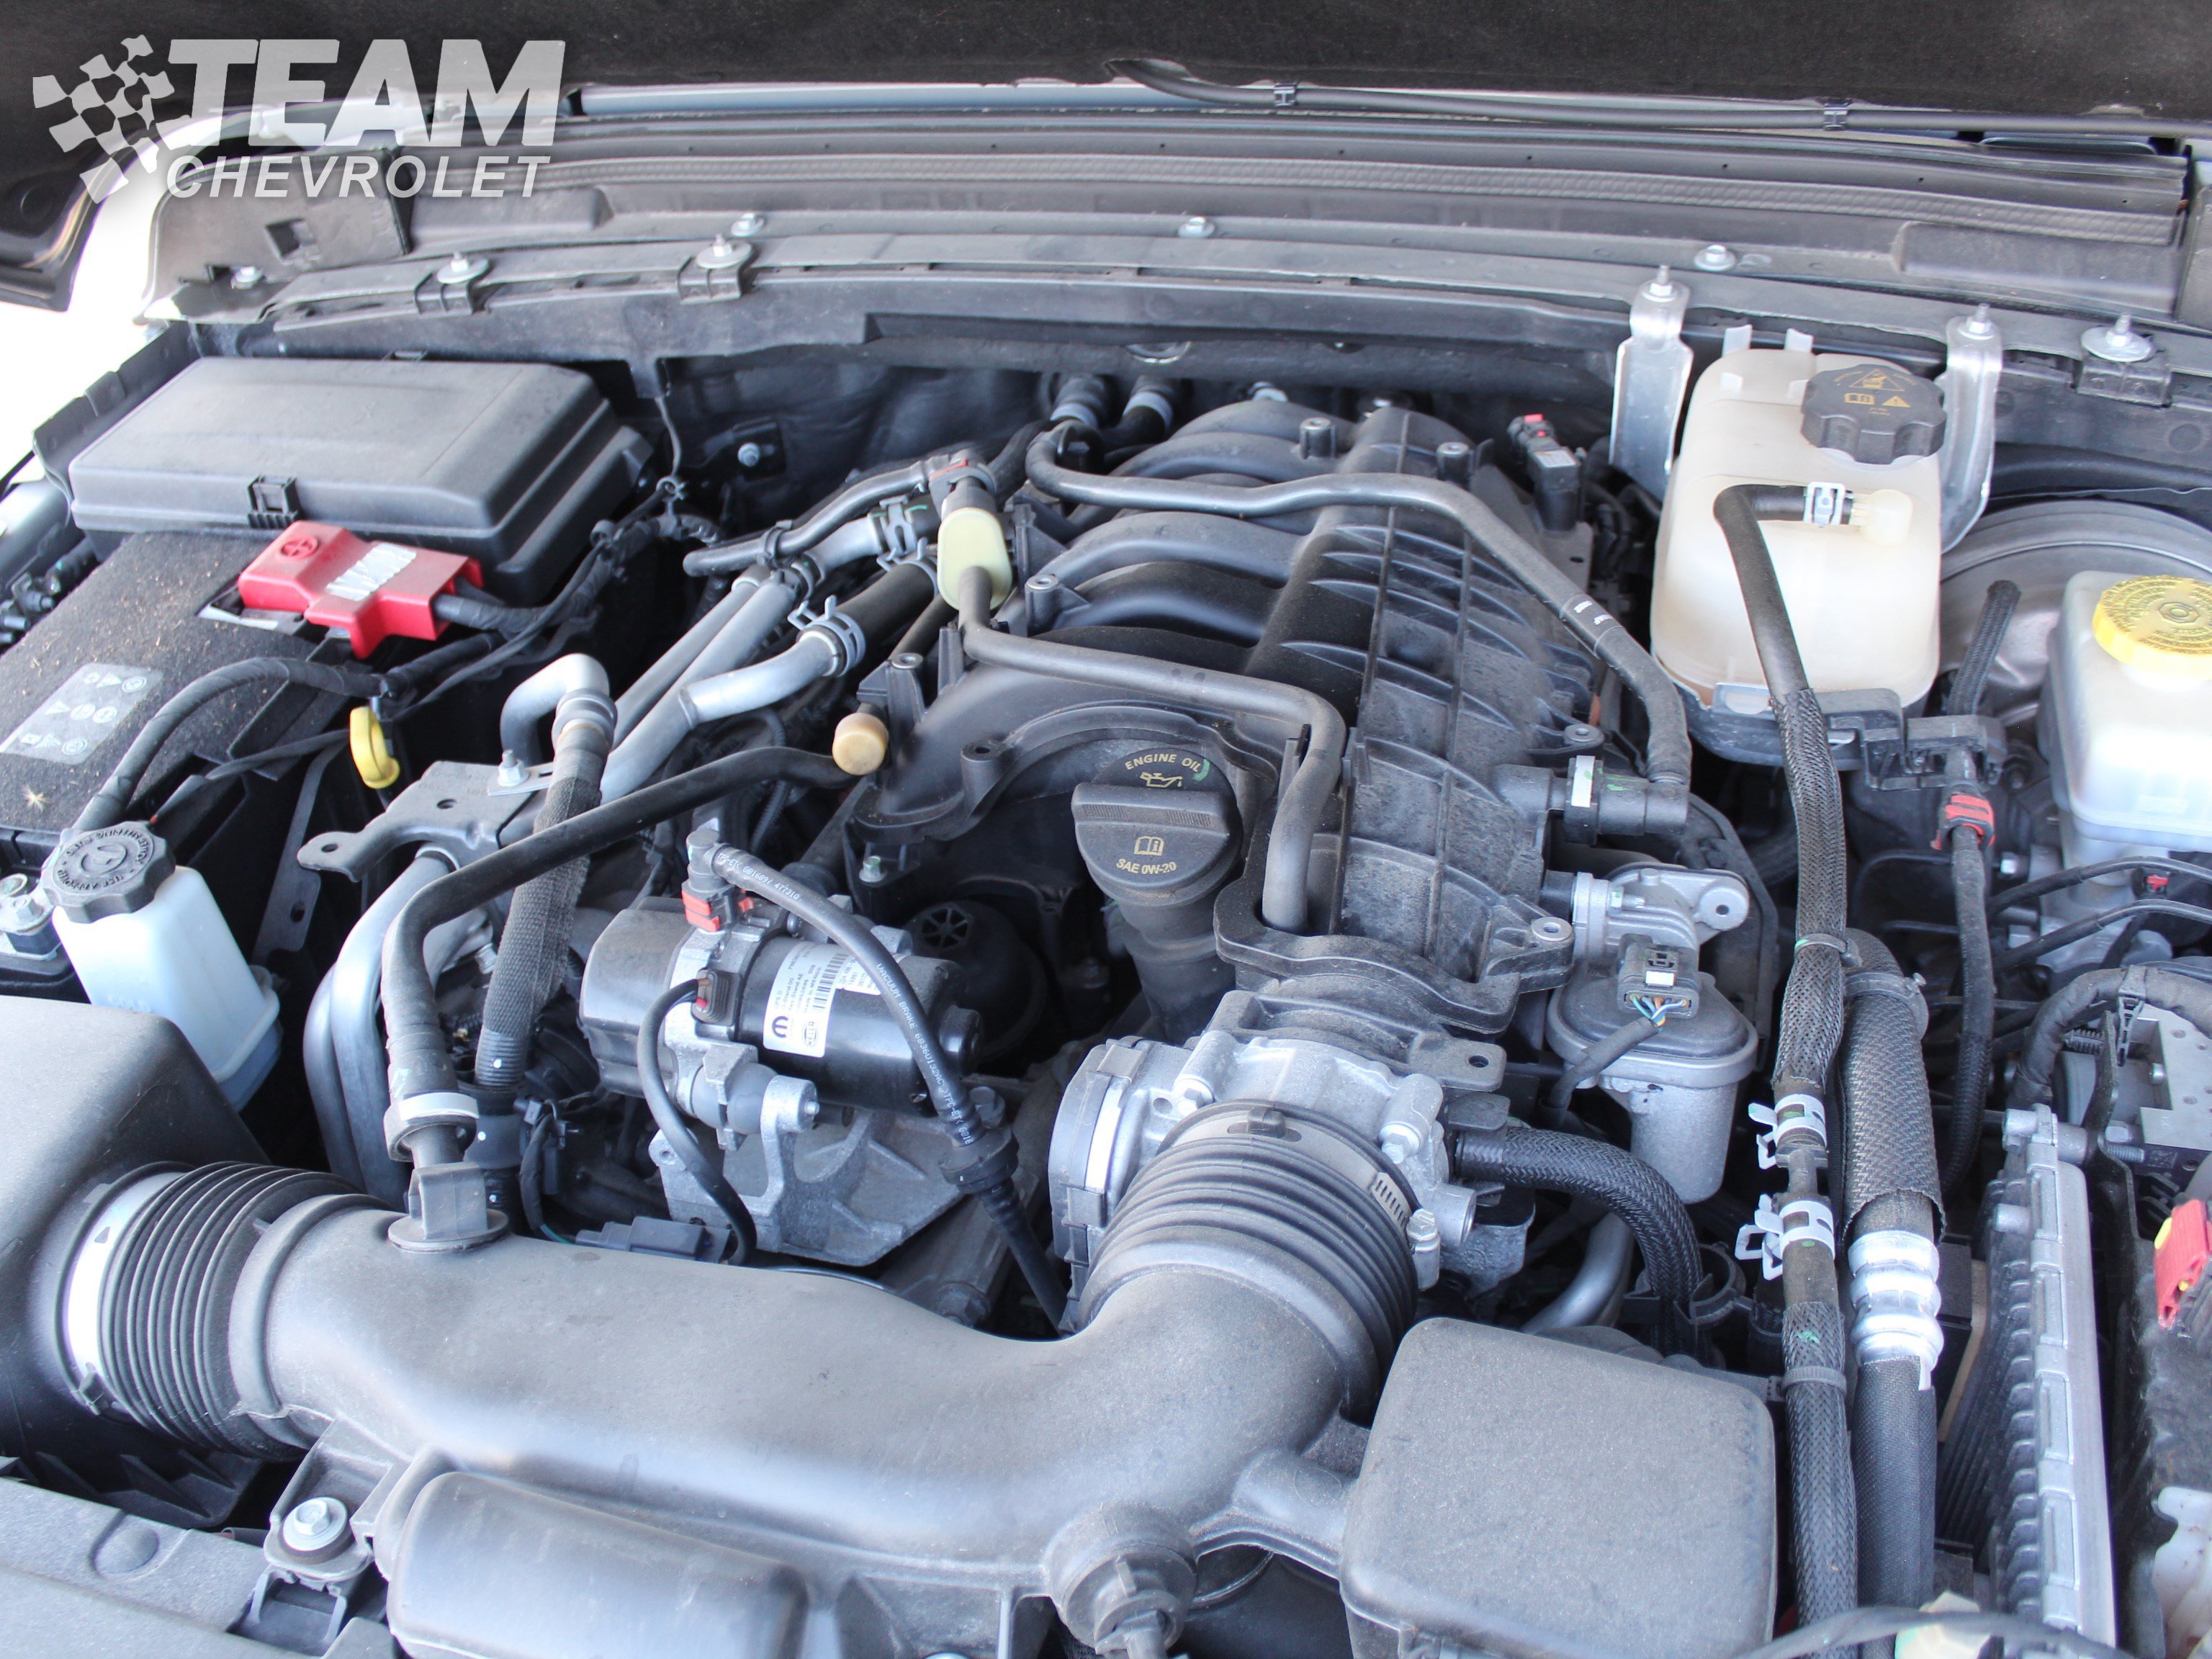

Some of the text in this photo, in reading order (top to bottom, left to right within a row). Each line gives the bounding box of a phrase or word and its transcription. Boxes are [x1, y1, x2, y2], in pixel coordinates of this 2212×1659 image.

[1125, 753, 1202, 773] ENGINE OIL
[1116, 858, 1177, 875] SAE 0W-20
[876, 963, 902, 999] VACUUM
[899, 1002, 918, 1030] BRAKE
